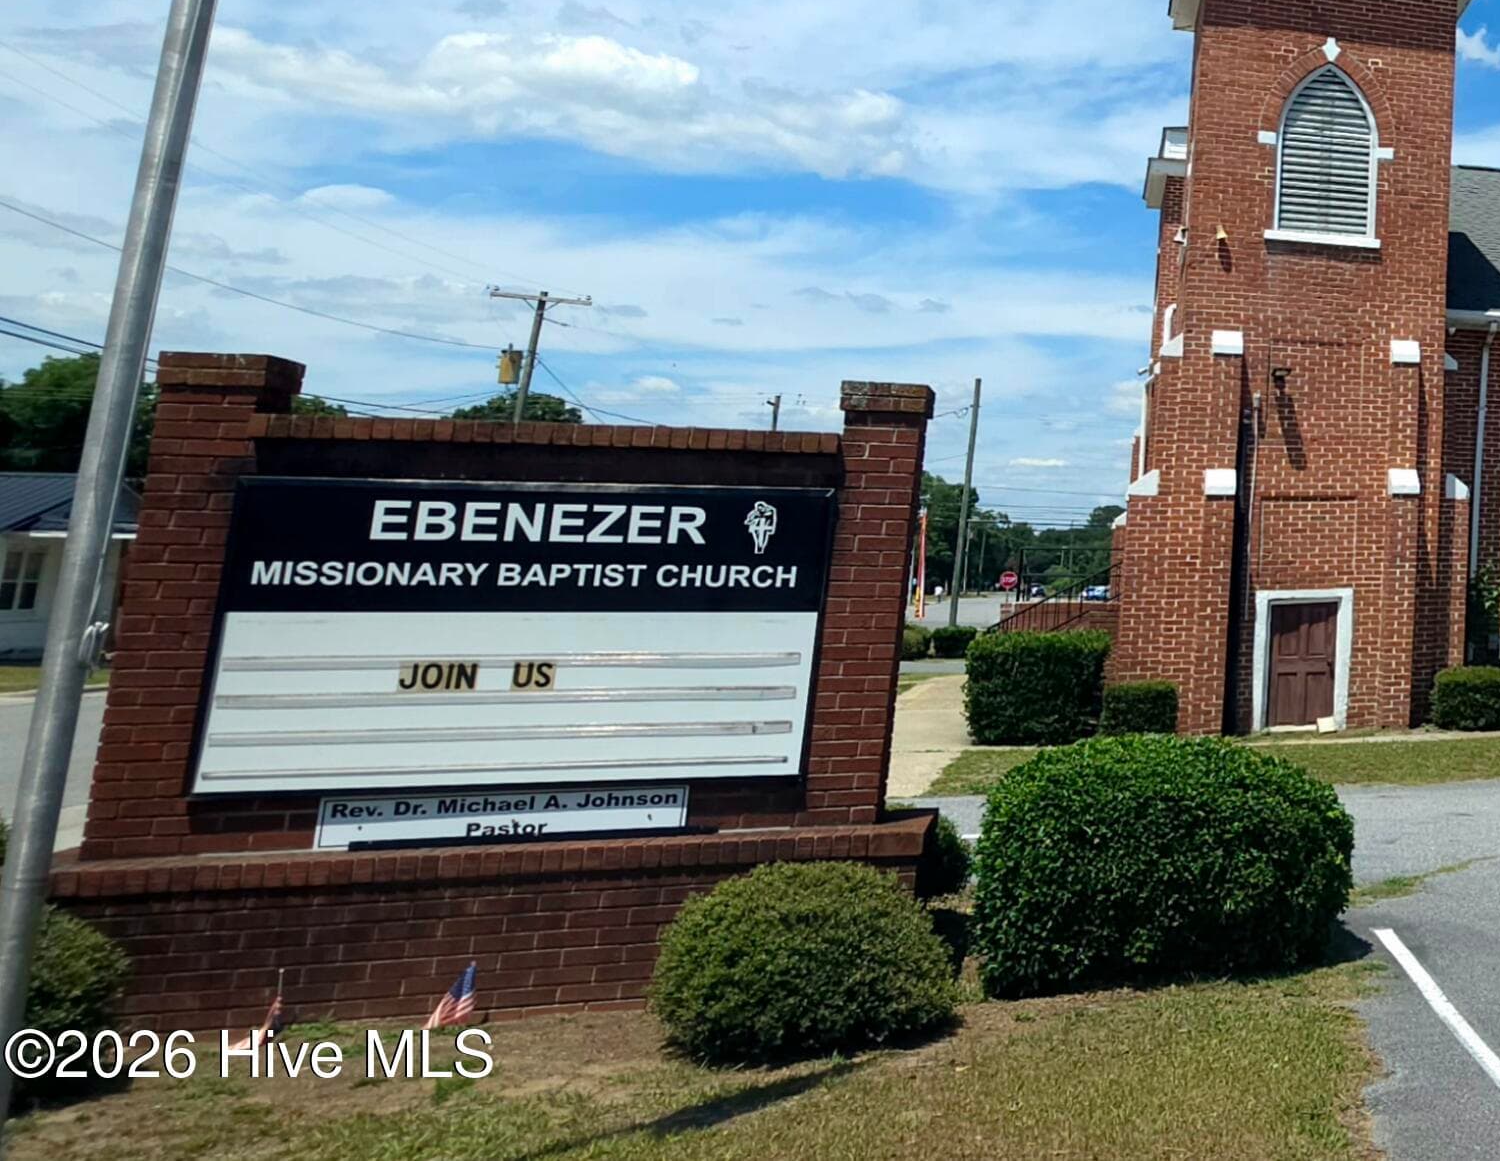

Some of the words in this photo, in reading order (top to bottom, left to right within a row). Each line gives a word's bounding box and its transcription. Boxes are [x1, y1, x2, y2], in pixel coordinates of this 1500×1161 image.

[369, 500, 706, 544] EBENEZER
[250, 560, 489, 586] MISSIONARY
[497, 562, 648, 587] BAPTIST
[656, 563, 797, 588] CHURCH
[399, 663, 478, 690] JOIN
[513, 662, 554, 689] US
[331, 803, 383, 819] Rev.
[393, 801, 427, 816] Dr.
[437, 795, 536, 814] Michael
[543, 795, 567, 810] A.
[577, 792, 678, 809] Johnson
[466, 820, 548, 837] Pastor
